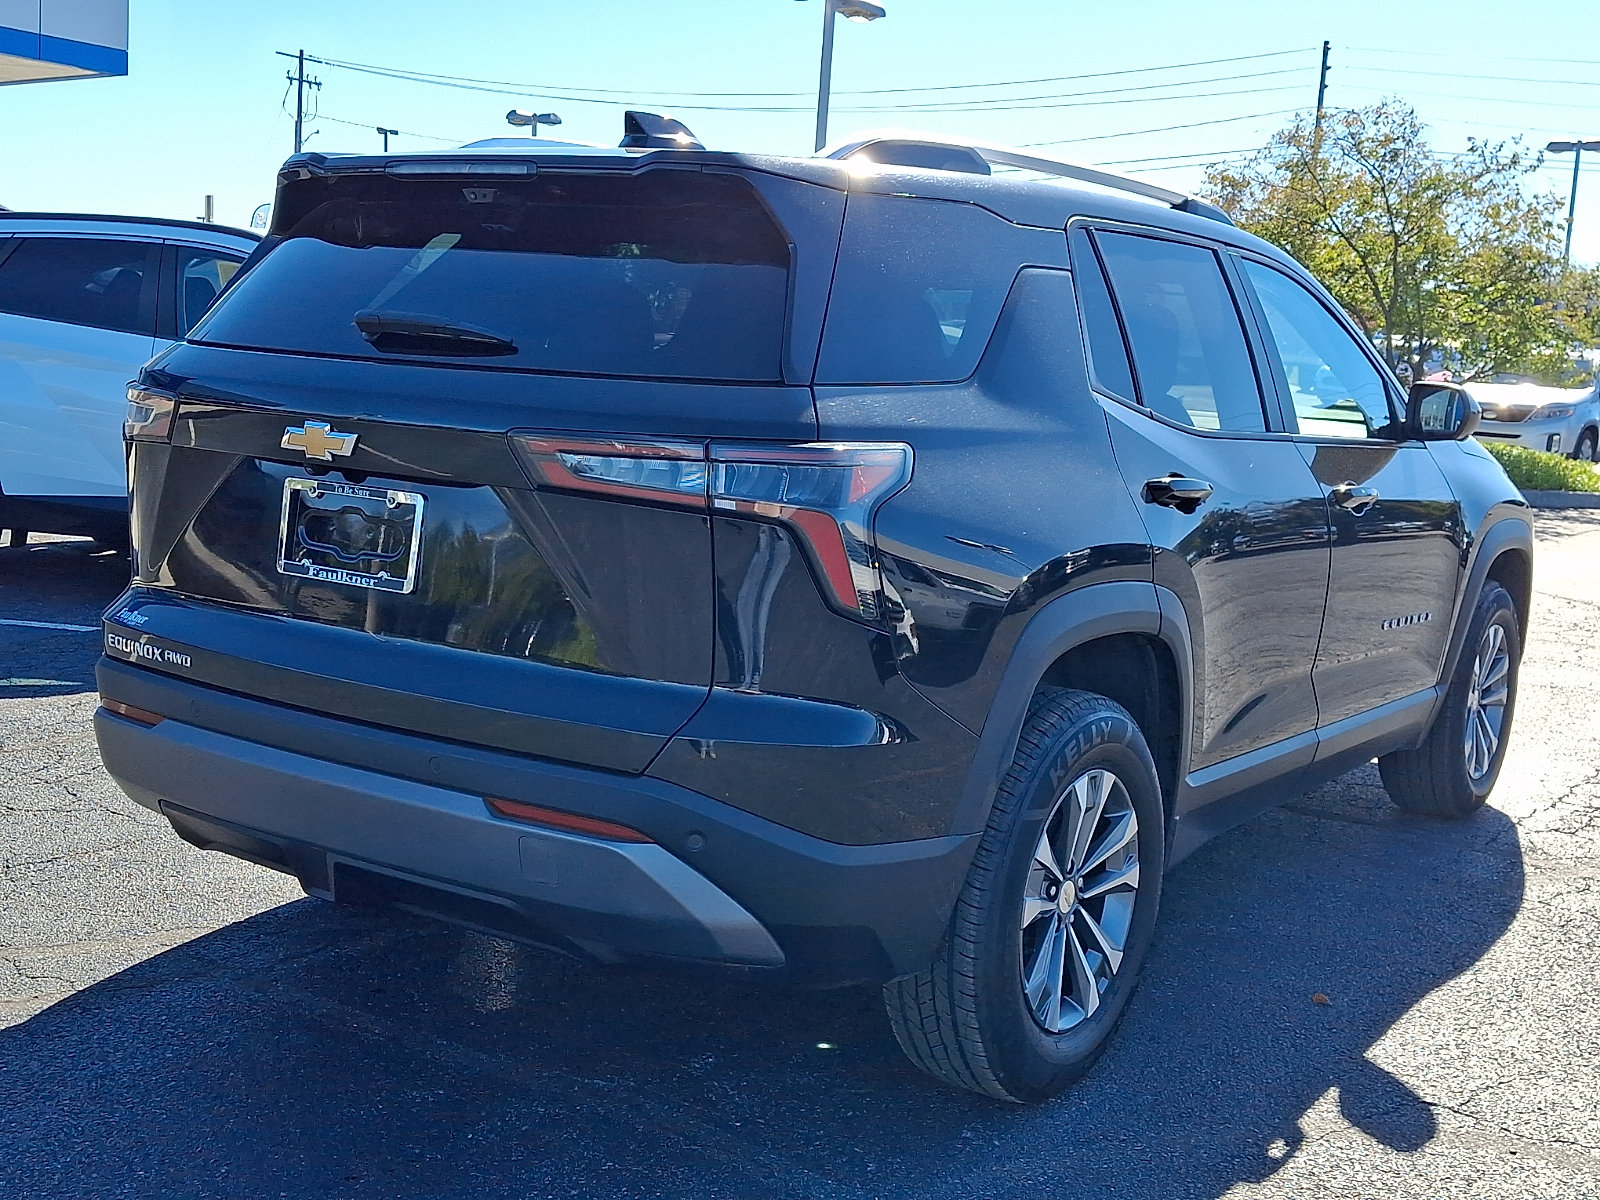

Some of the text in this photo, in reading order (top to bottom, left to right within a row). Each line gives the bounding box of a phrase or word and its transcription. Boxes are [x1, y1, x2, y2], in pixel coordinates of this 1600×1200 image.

[333, 484, 371, 497] To Be Sure
[308, 566, 379, 587] Faulkner
[1381, 611, 1432, 631] EQUINOX
[107, 633, 192, 668] EQUINOX AWD
[1049, 720, 1112, 790] KELLY
